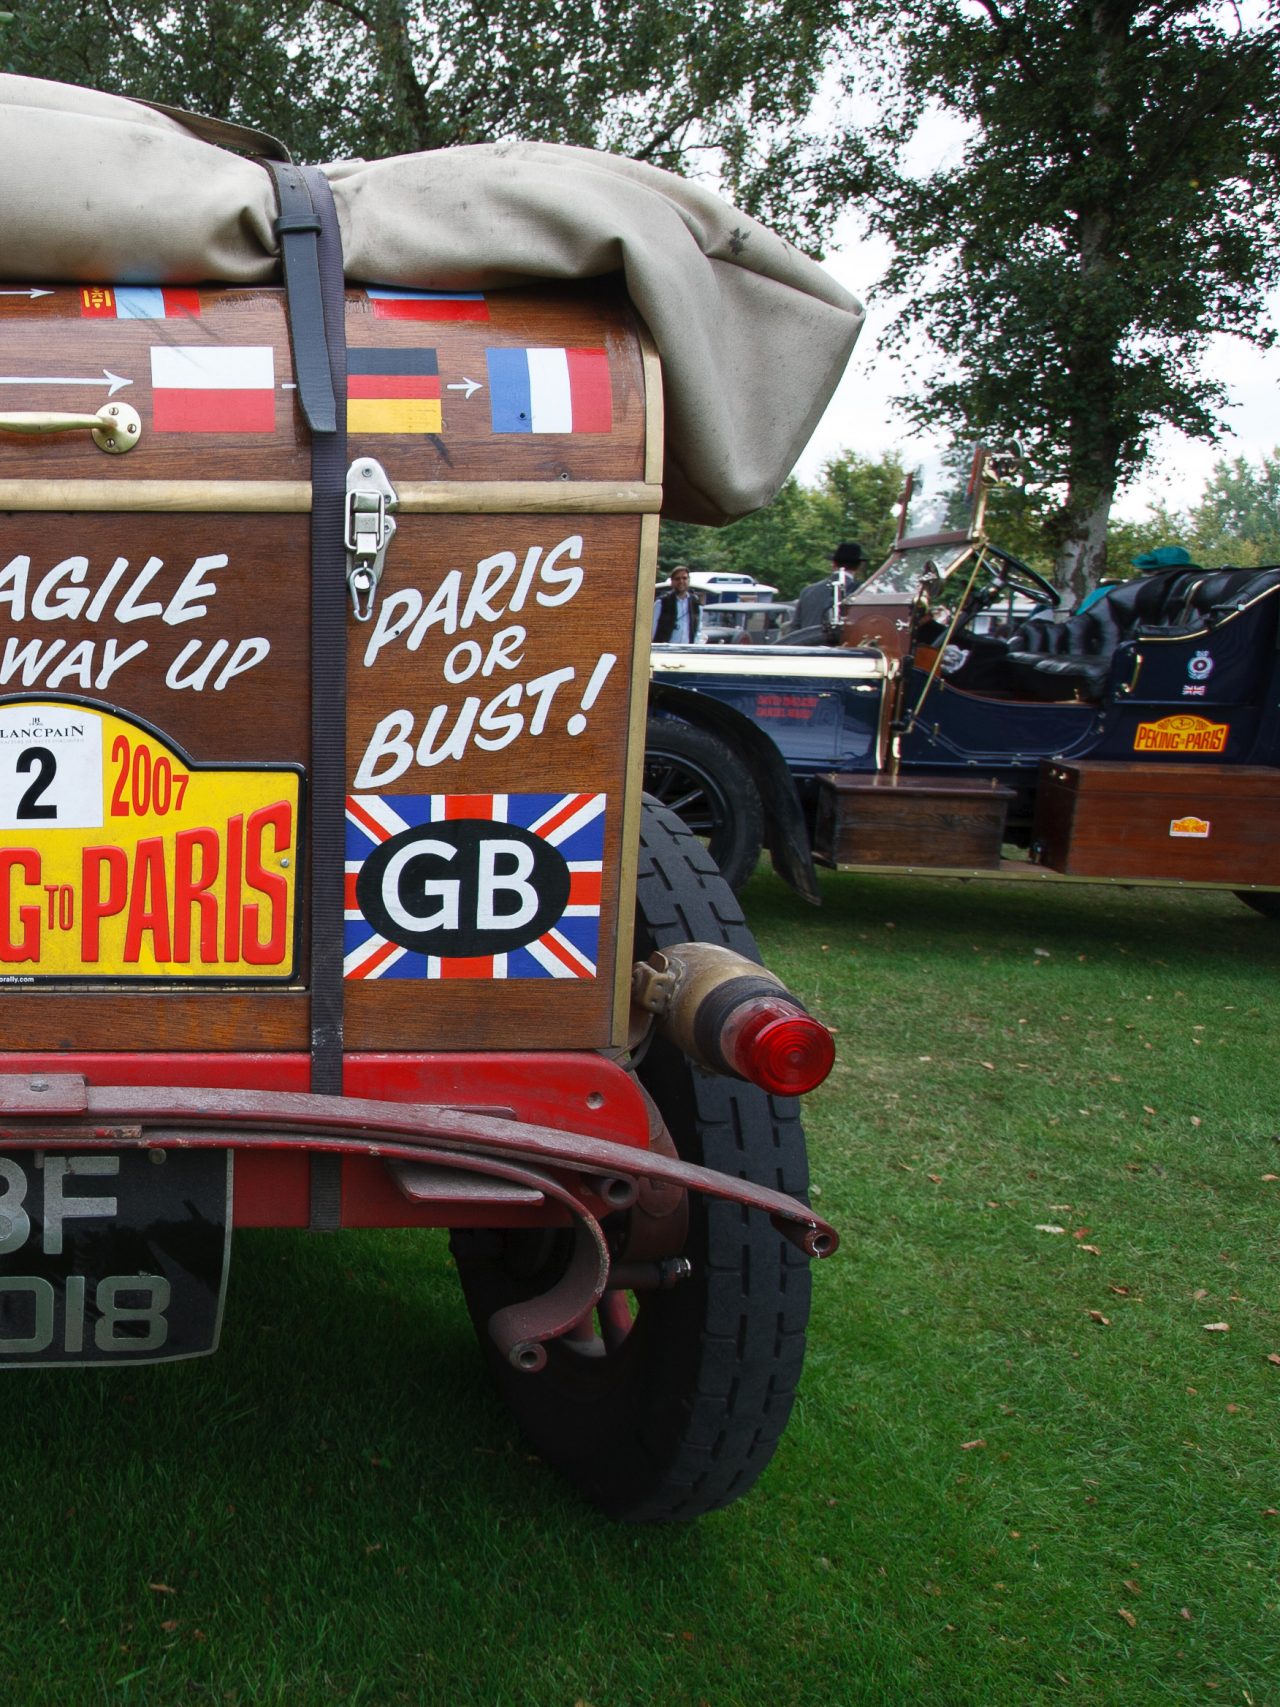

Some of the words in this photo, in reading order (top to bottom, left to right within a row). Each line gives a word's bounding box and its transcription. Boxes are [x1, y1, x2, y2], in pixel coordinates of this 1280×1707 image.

[364, 536, 584, 668] PARIS
[0, 637, 148, 690] WAY
[166, 637, 271, 691] UP
[443, 626, 526, 684] OR
[353, 653, 617, 789] BUST!
[1135, 726, 1181, 749] PEKING
[1184, 727, 1225, 750] PARIS
[16, 746, 58, 820] 2
[110, 736, 189, 817] 2007
[44, 885, 74, 930] TO
[81, 800, 293, 965] PARIS
[381, 839, 539, 932] GB
